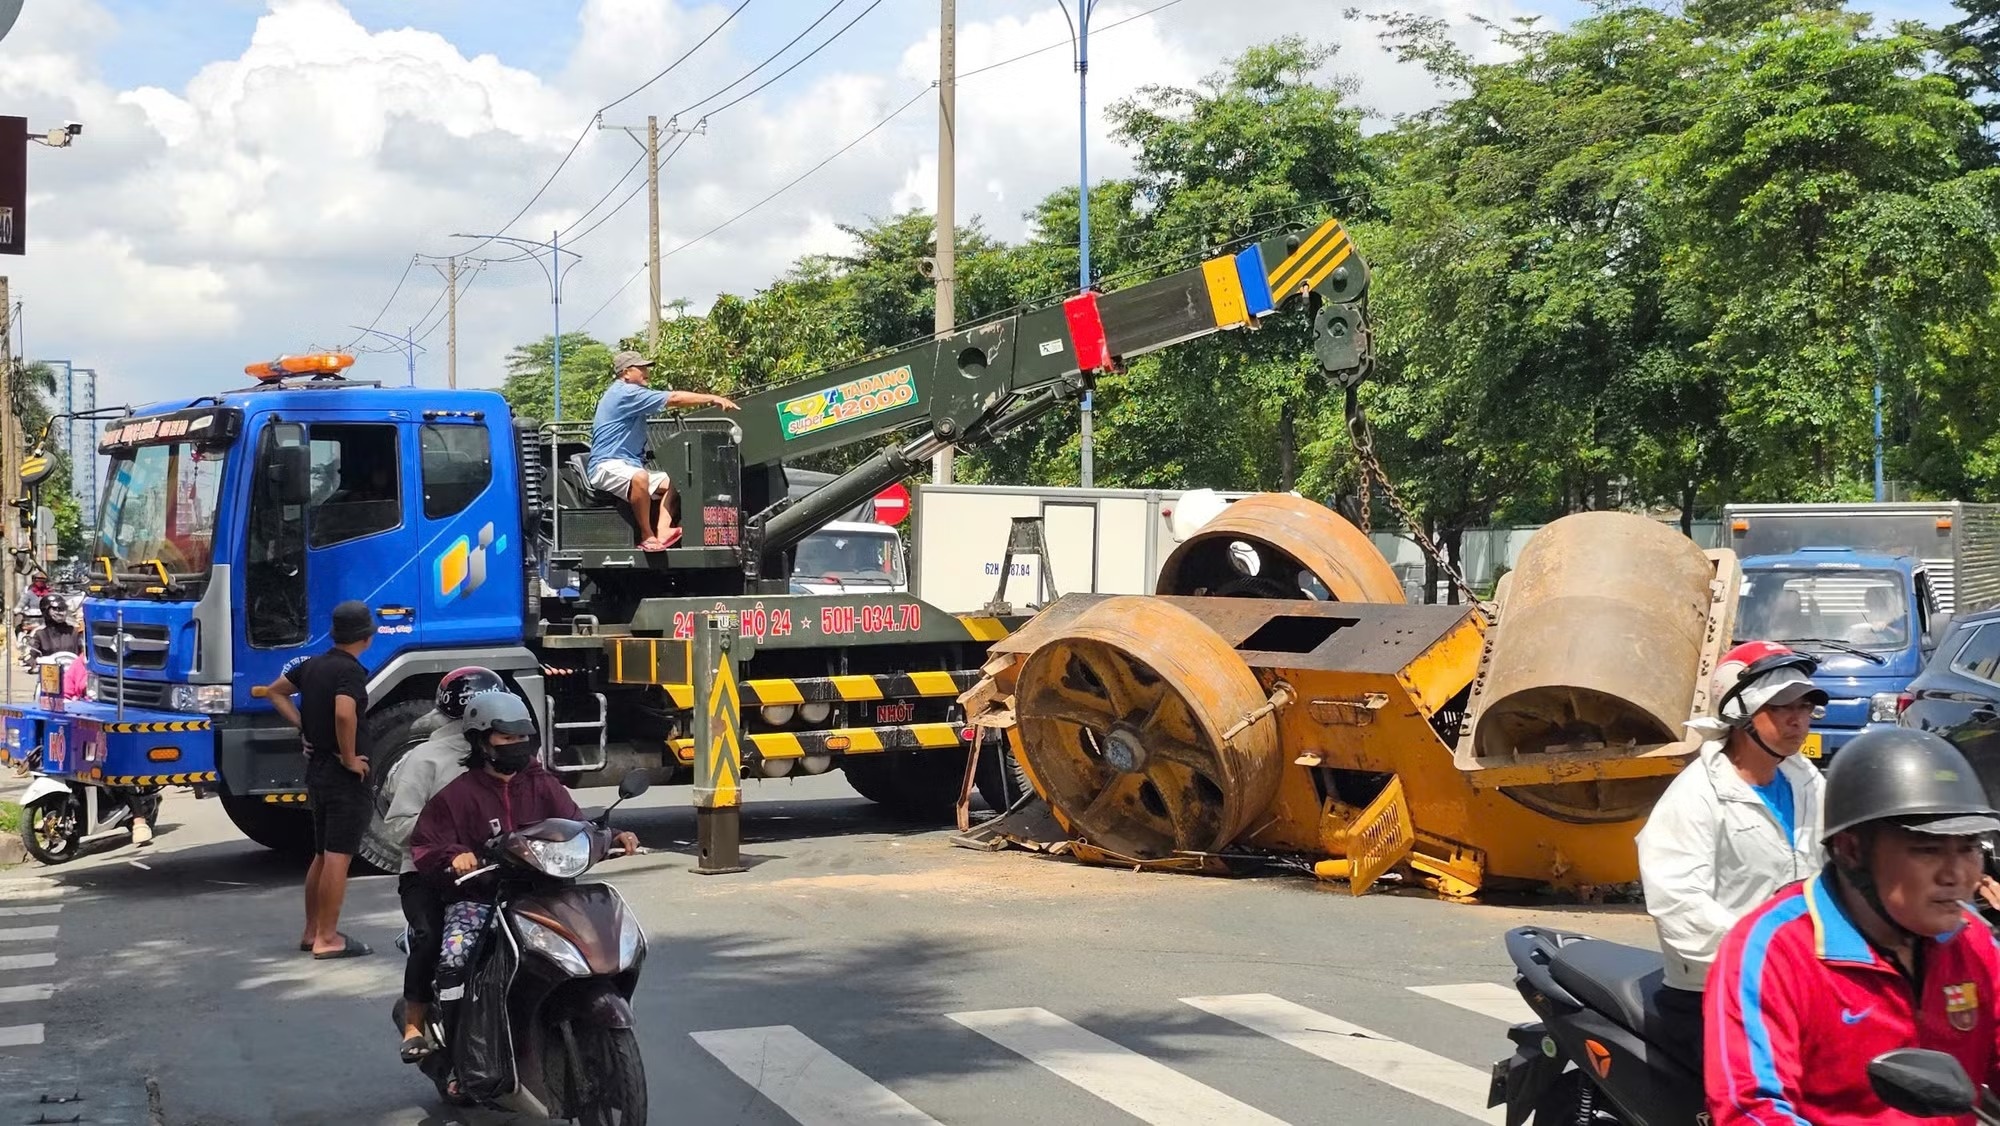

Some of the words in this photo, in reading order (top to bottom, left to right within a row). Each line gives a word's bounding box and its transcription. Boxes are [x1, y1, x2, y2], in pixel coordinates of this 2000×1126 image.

[841, 367, 909, 399] TADANO
[831, 384, 913, 420] 12000
[788, 413, 823, 433] super
[673, 611, 694, 639] 24
[741, 601, 767, 644] HỘ
[771, 608, 792, 636] 24
[820, 603, 921, 635] 50H-034.70
